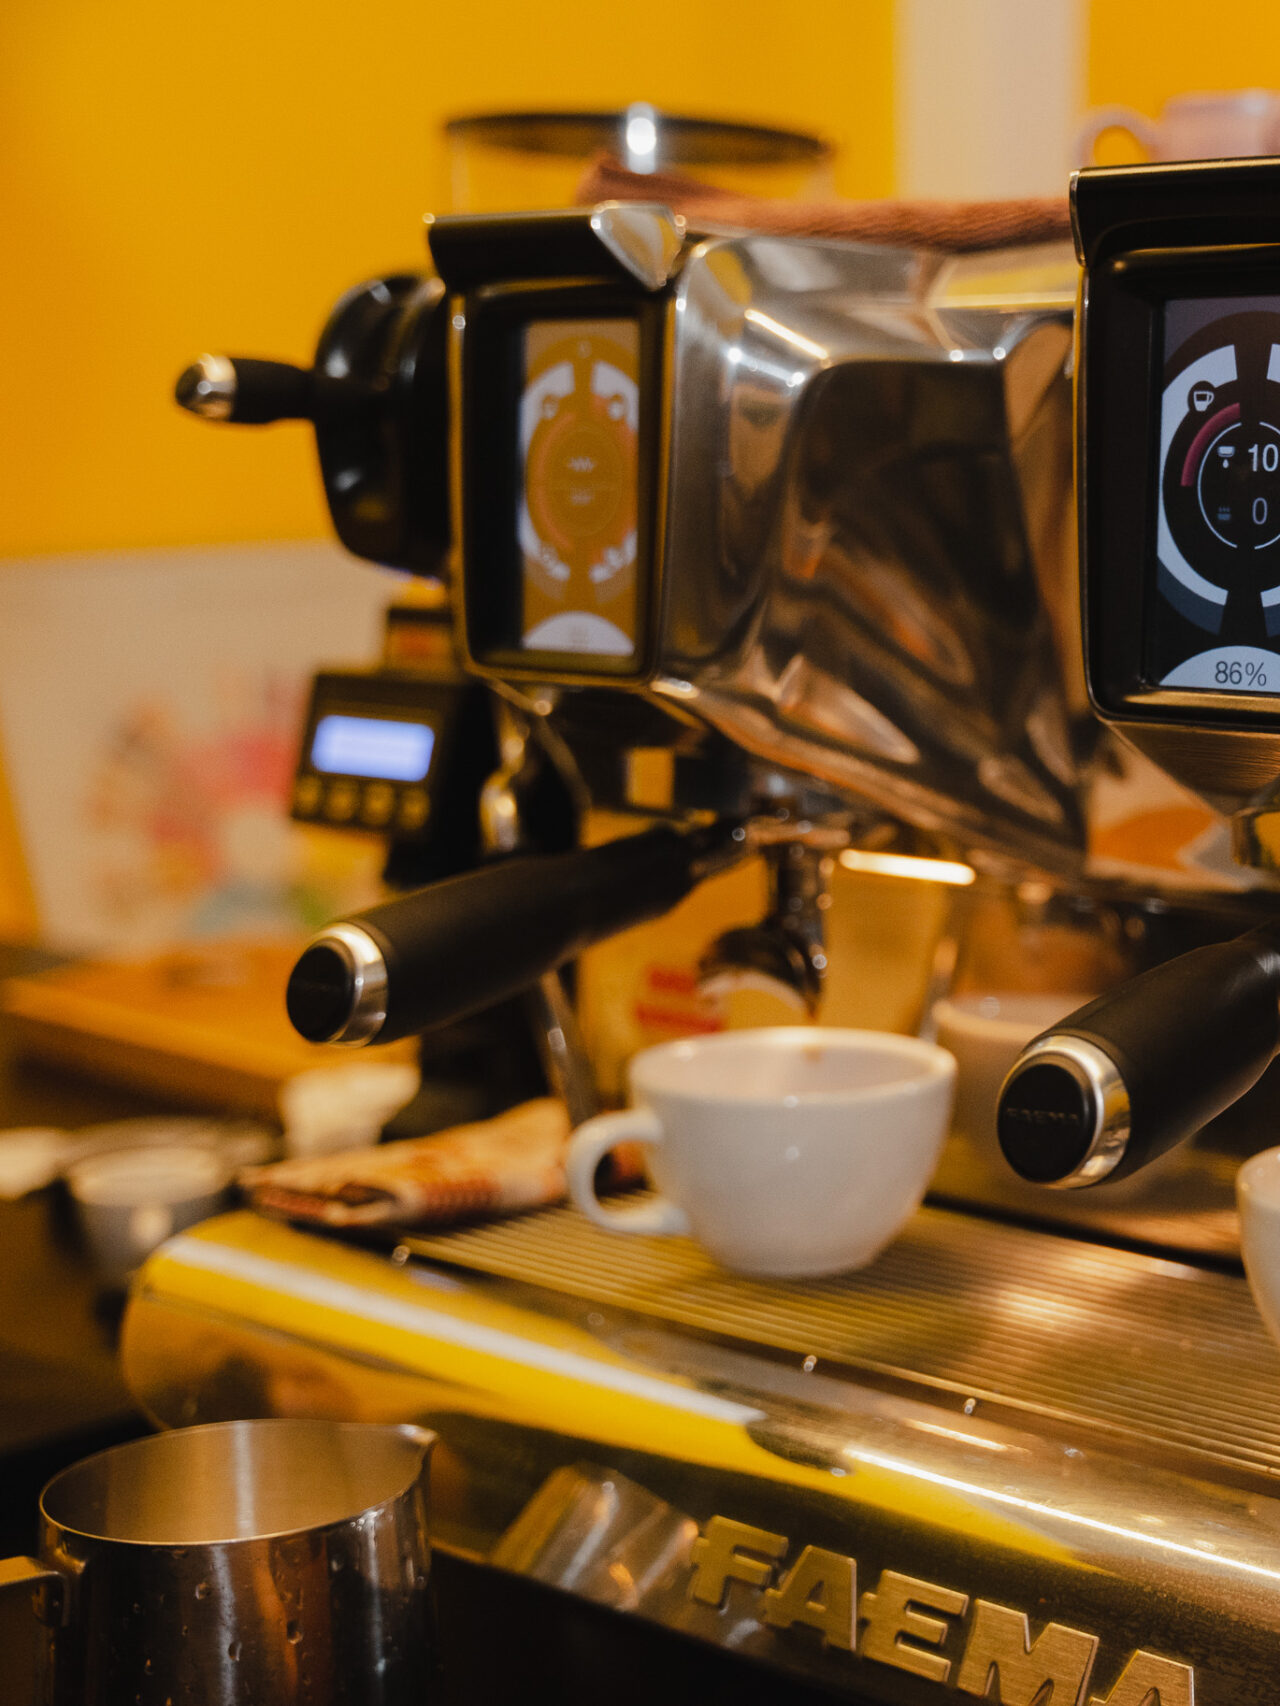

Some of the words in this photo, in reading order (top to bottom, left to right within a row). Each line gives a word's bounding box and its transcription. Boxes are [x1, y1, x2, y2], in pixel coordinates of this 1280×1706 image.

[1248, 443, 1279, 472] 10
[1252, 497, 1268, 525] 0
[1214, 660, 1267, 688] 86%
